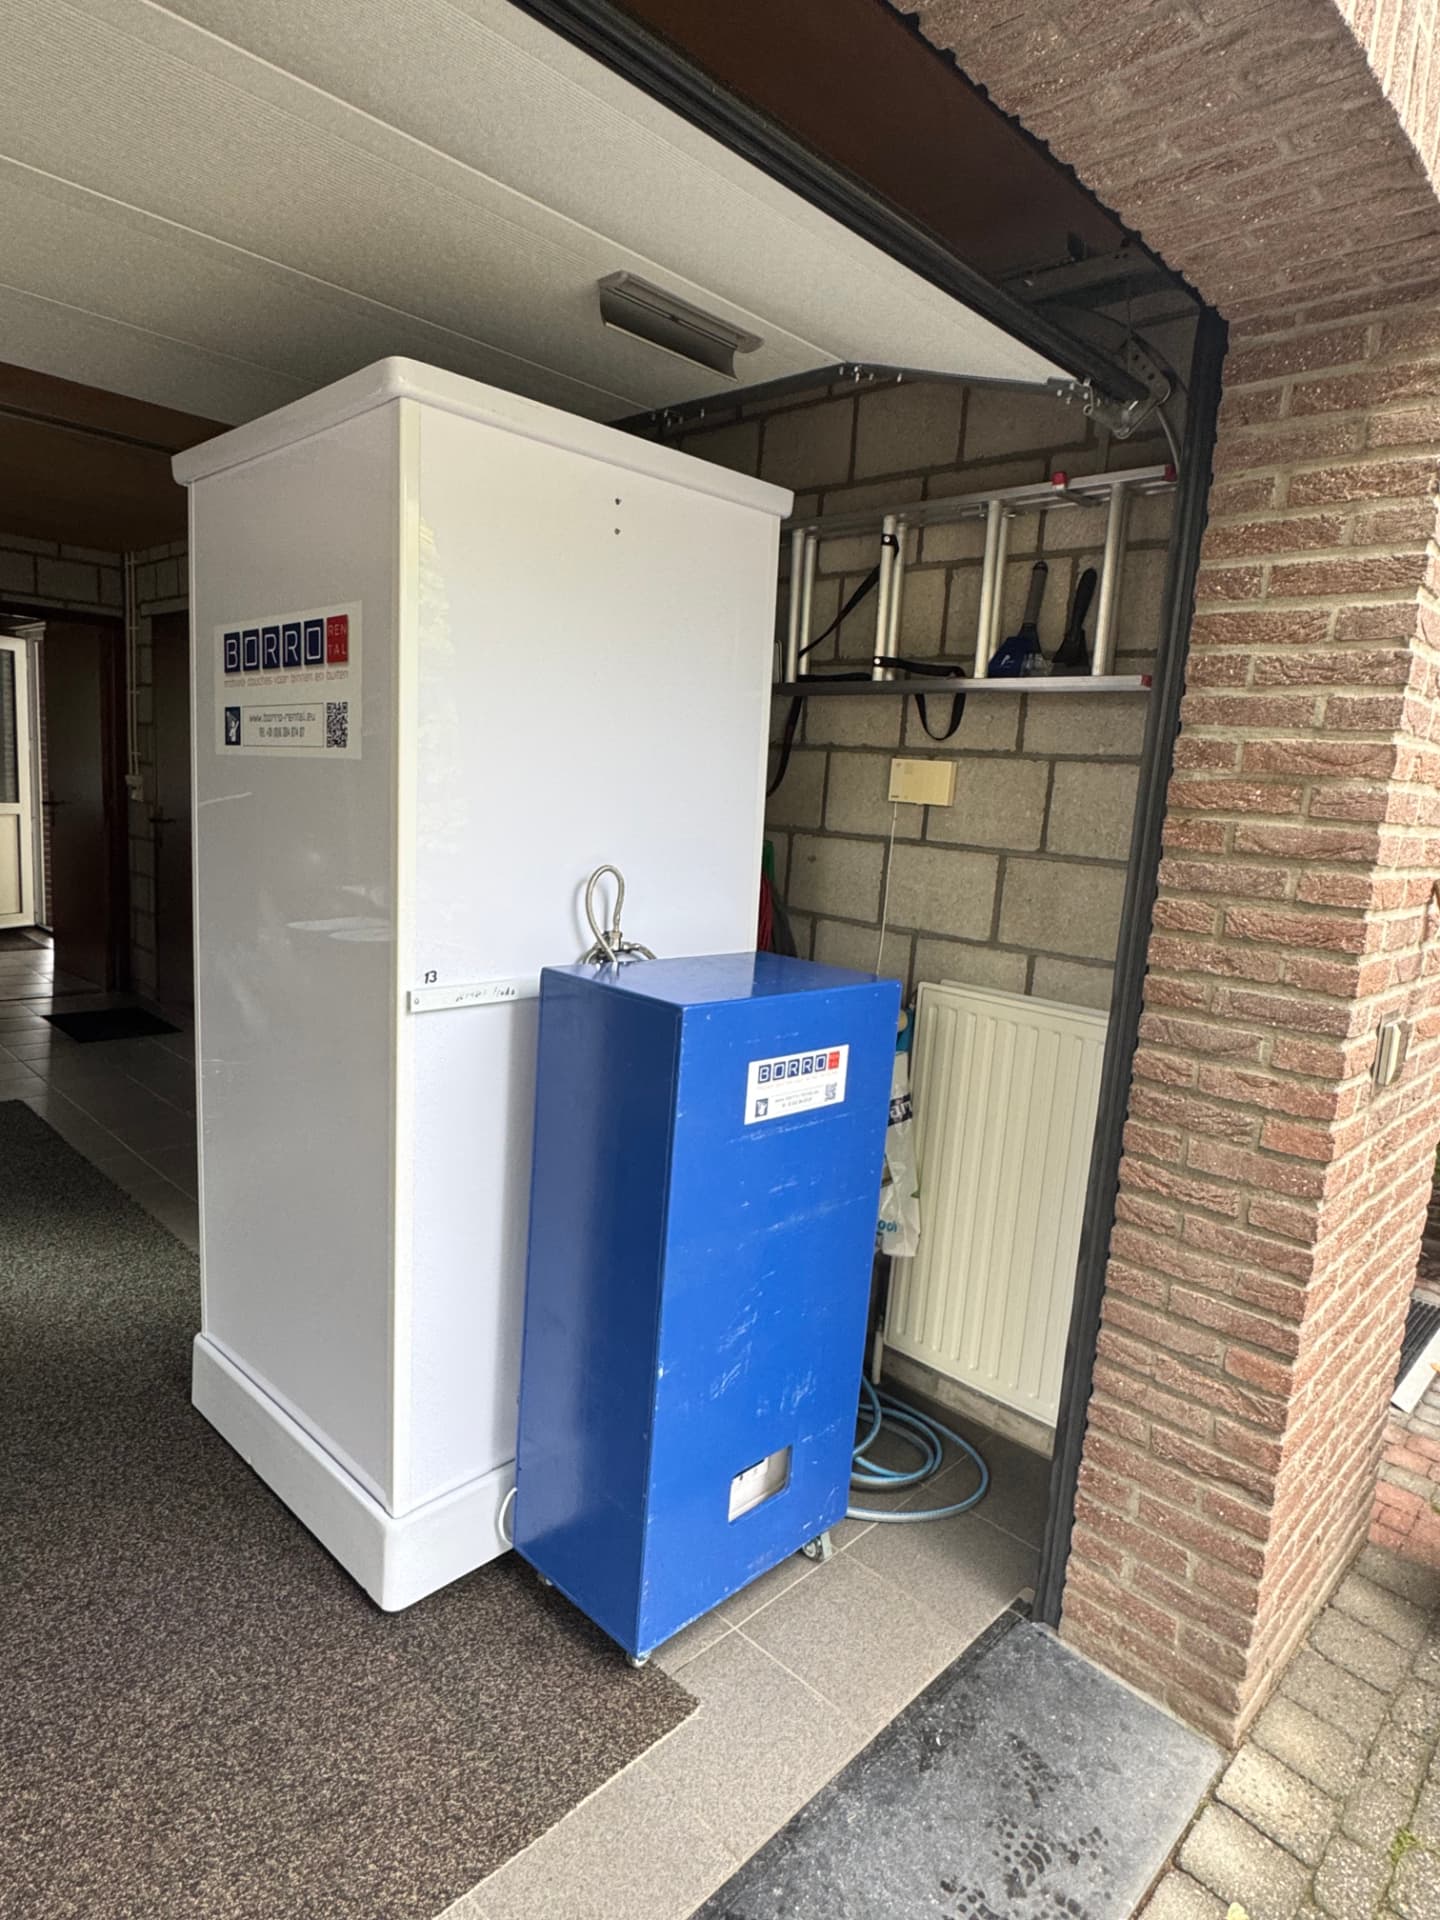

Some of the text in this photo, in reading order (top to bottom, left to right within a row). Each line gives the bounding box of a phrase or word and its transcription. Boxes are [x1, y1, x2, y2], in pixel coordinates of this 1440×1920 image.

[328, 623, 347, 637] REN
[225, 626, 322, 669] BORRO
[328, 643, 347, 656] TAL
[424, 970, 438, 985] 13
[759, 1054, 828, 1084] BORRO
